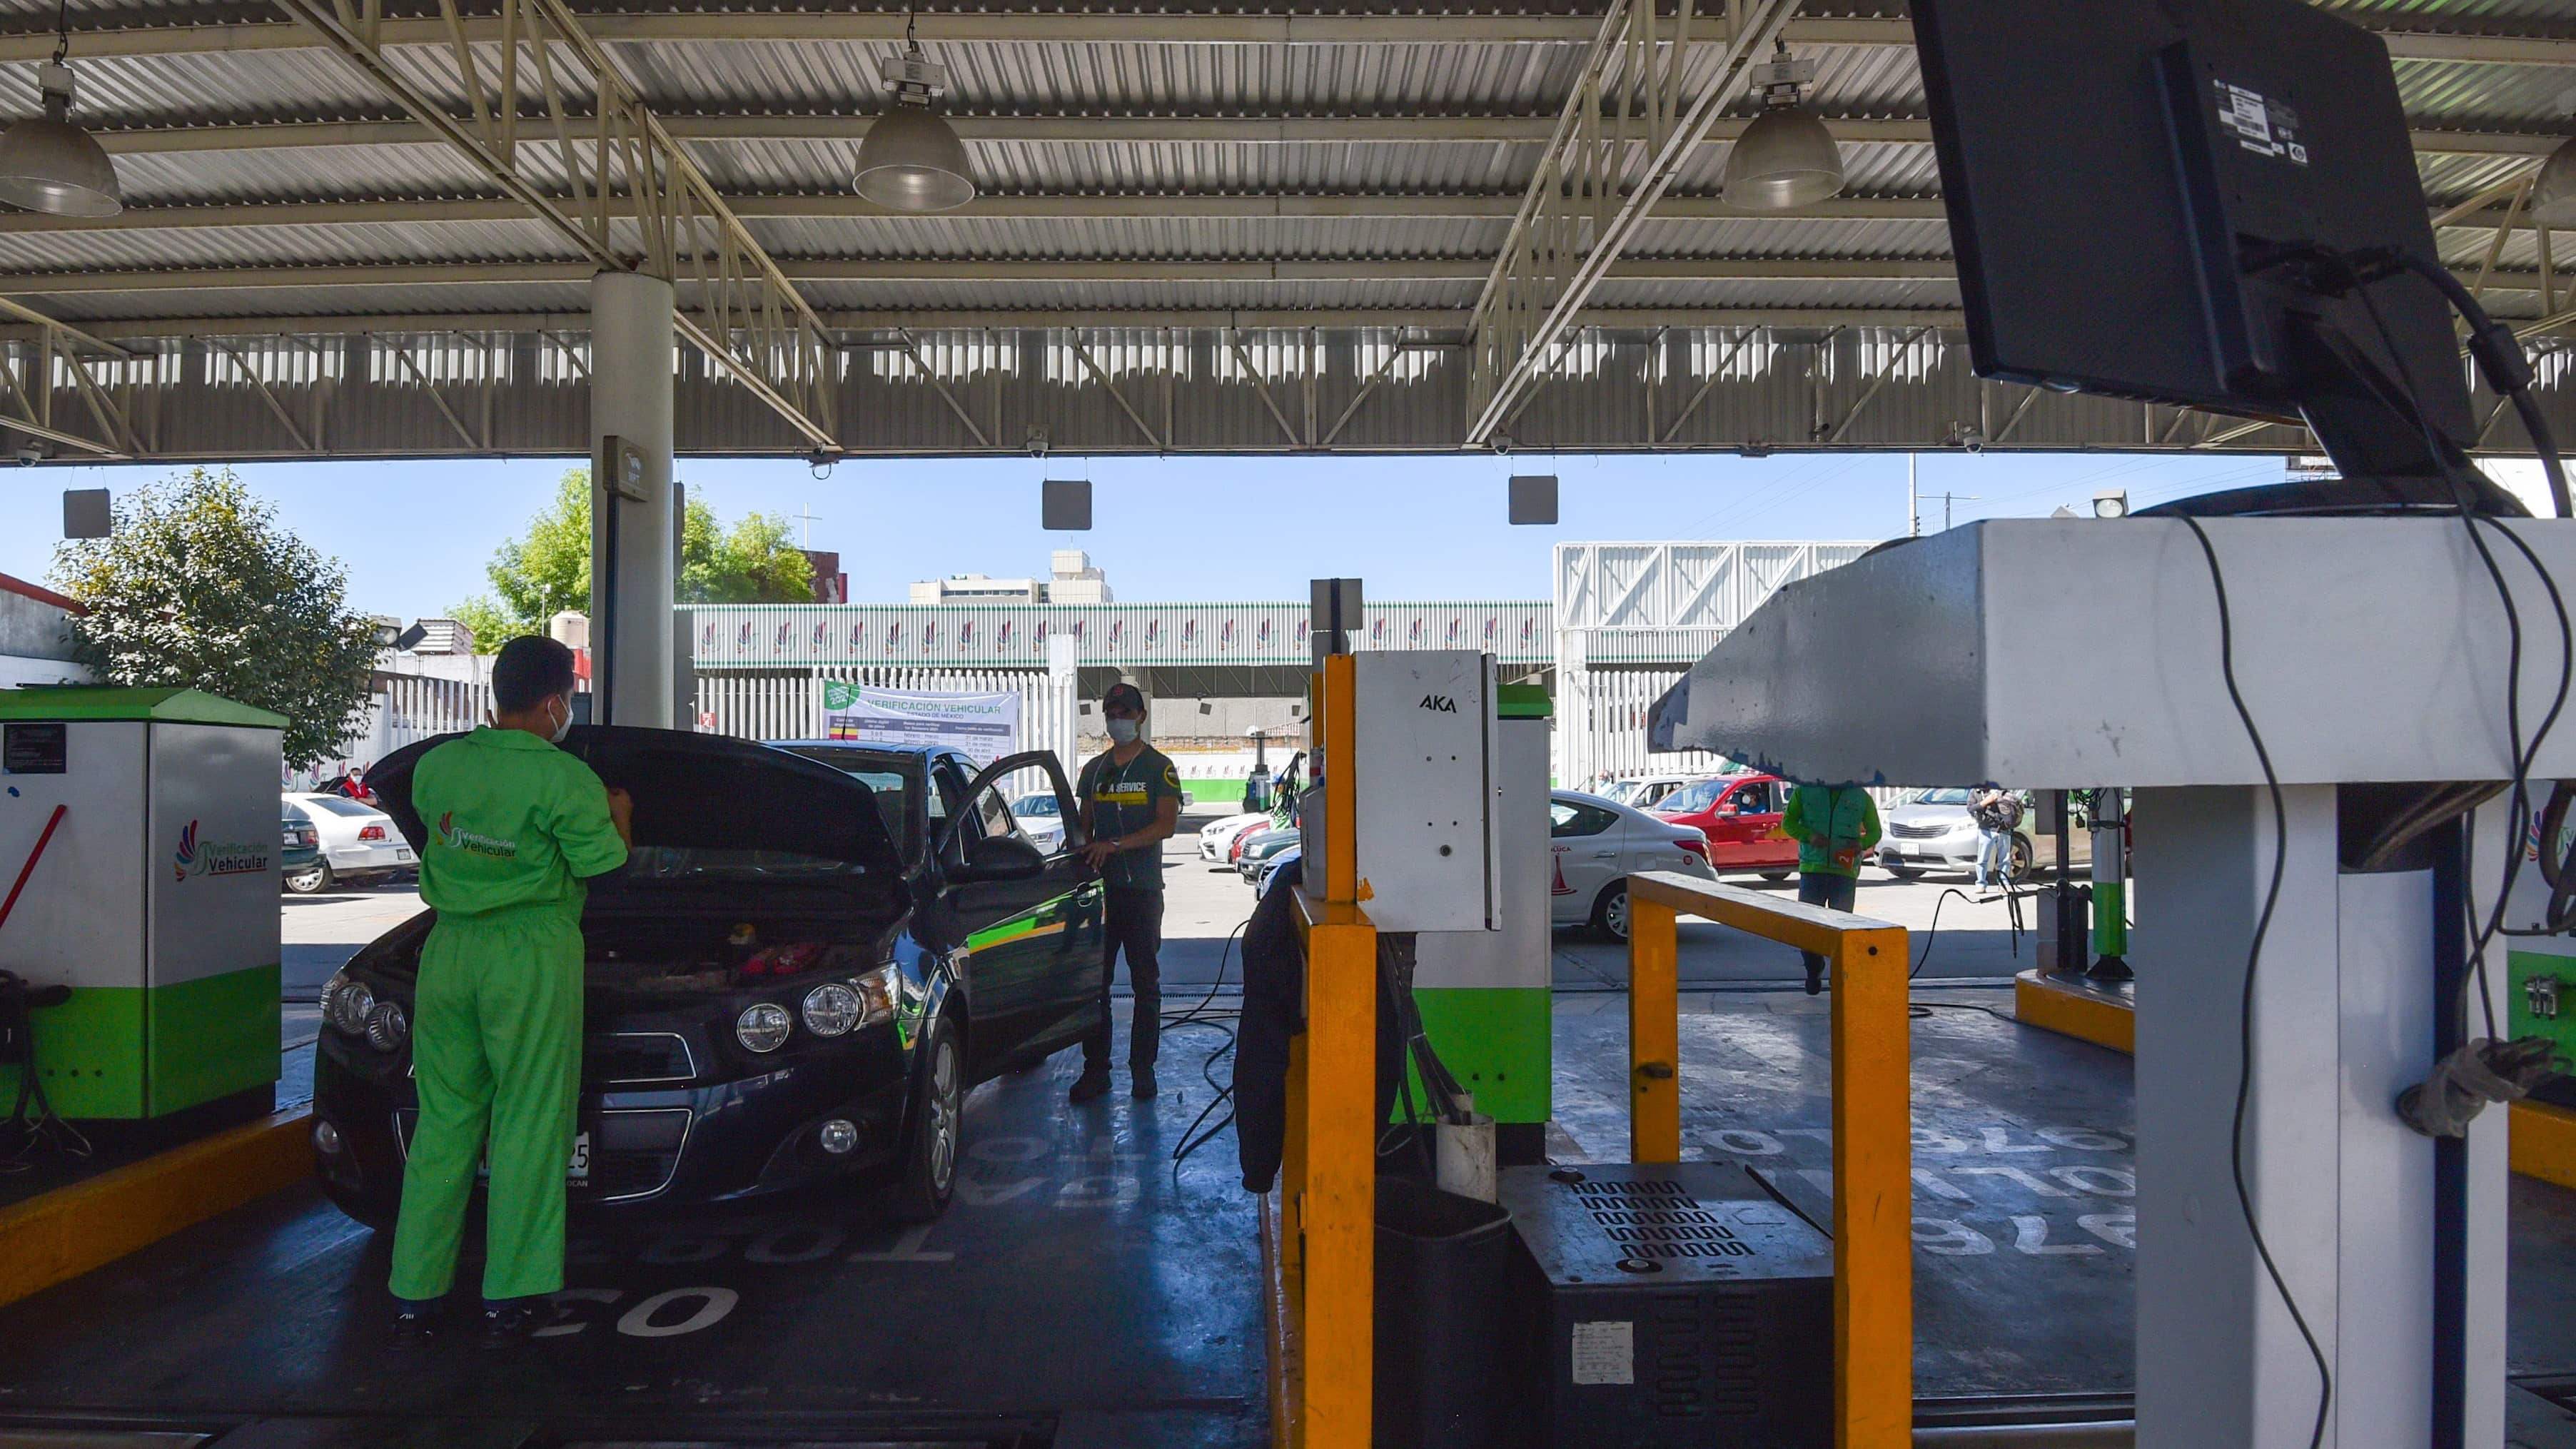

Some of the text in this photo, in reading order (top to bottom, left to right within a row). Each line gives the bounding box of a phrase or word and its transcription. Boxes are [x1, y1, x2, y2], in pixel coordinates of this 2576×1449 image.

[830, 695, 849, 705] 202
[868, 699, 1001, 715] VERIFICACIÓN VEHICULAR
[1419, 695, 1456, 713] AKA
[1116, 782, 1146, 793] SERVICE
[207, 842, 268, 855] Verificación
[462, 839, 516, 857] Vehicular
[209, 854, 268, 872] Vehicular
